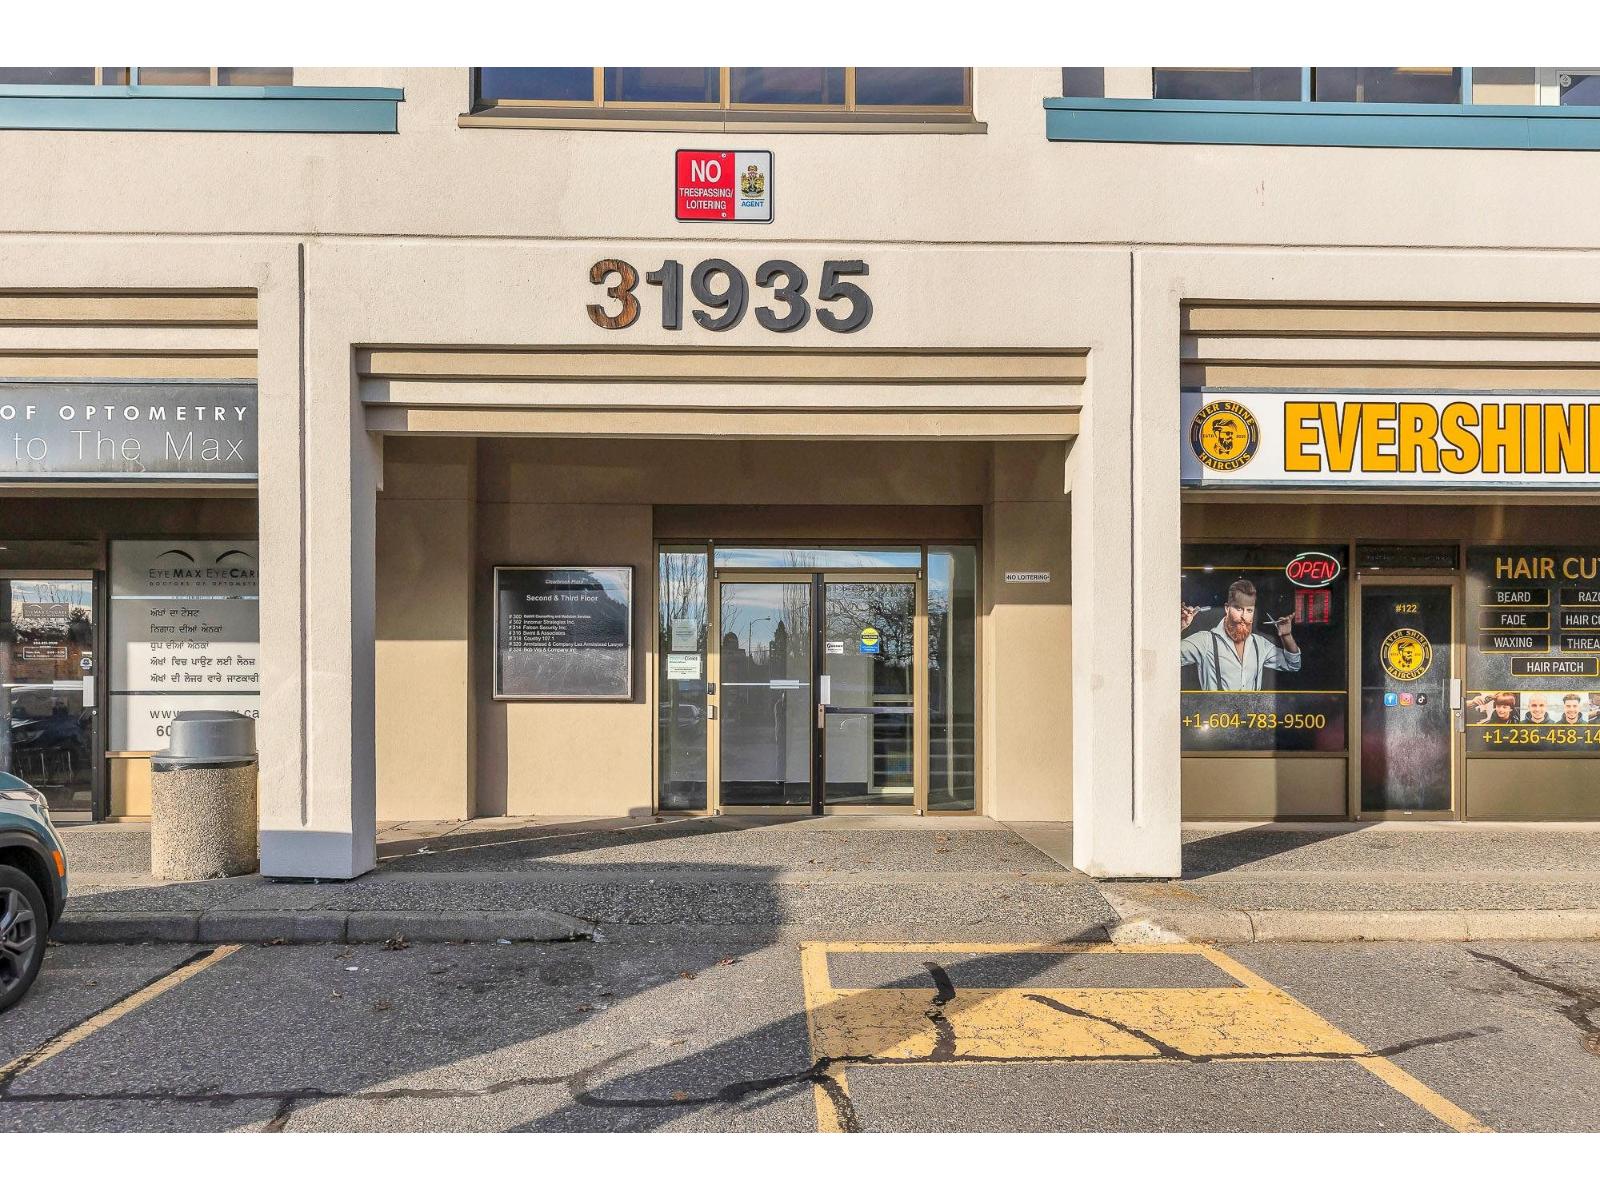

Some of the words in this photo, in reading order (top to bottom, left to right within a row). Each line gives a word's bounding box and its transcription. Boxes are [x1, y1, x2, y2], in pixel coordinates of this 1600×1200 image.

[691, 160, 722, 183] NO
[679, 187, 734, 198] TRESPASSING/
[686, 200, 727, 210] LOITERING
[586, 258, 873, 334] 31935
[0, 405, 36, 421] OF
[59, 406, 248, 421] OPTOMETRY
[1195, 403, 1220, 424] EVER
[1224, 402, 1256, 425] SHINE
[13, 432, 48, 461] to
[70, 430, 142, 461] The
[165, 431, 245, 461] Max
[1199, 452, 1251, 470] HAIRCUTS
[1288, 561, 1336, 579] OPEN
[1496, 557, 1555, 579] HAIR
[1562, 557, 1600, 579] CU
[1497, 592, 1531, 602] BEARD
[1578, 592, 1600, 602] RAZ
[1395, 604, 1417, 613] #122
[1501, 615, 1526, 625] FADE
[1566, 615, 1589, 625] HAIR
[1494, 638, 1533, 648] WAXING
[1527, 662, 1549, 672] HAIR
[1553, 662, 1584, 672] PATCH
[1182, 714, 1326, 729] +1-604-783-9500
